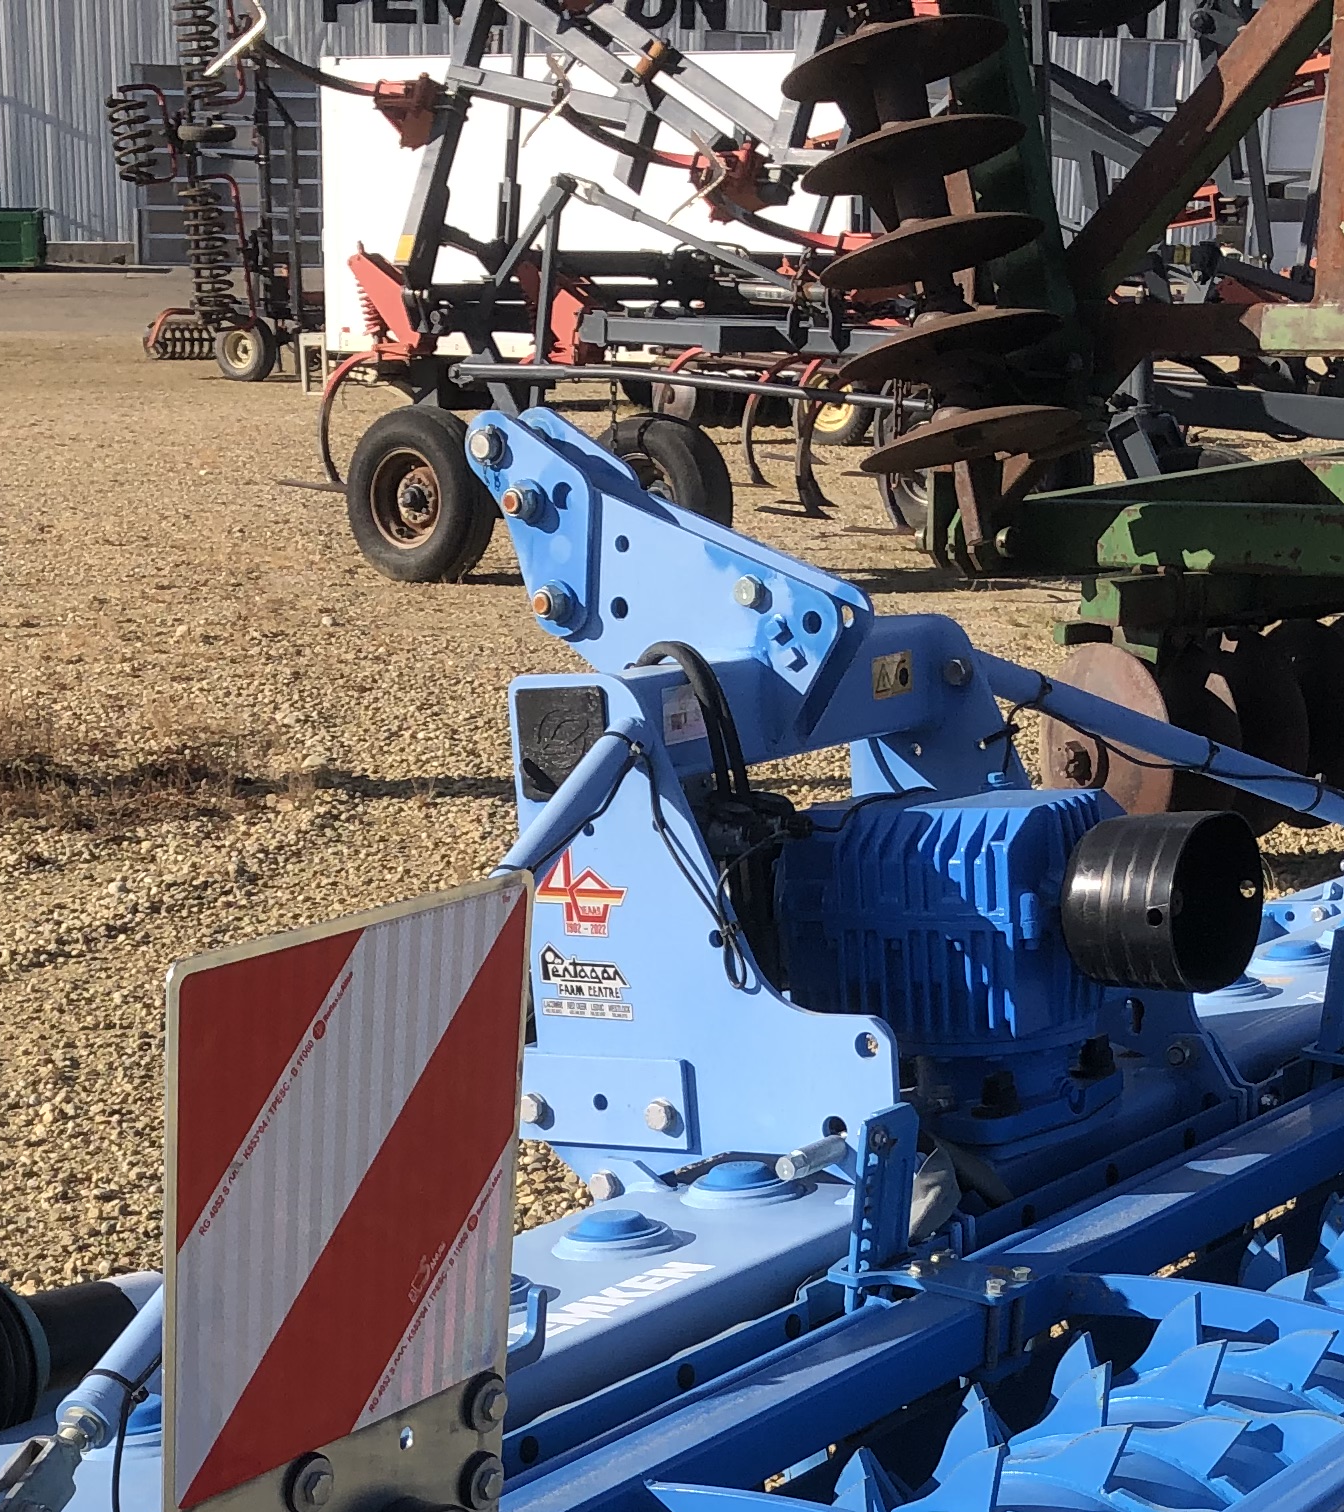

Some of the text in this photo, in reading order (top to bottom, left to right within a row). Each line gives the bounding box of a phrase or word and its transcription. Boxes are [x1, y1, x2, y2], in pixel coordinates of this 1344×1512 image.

[559, 984, 621, 998] FARM CENTRE
[198, 1218, 212, 1237] RG
[508, 1261, 716, 1342] EMKEN
